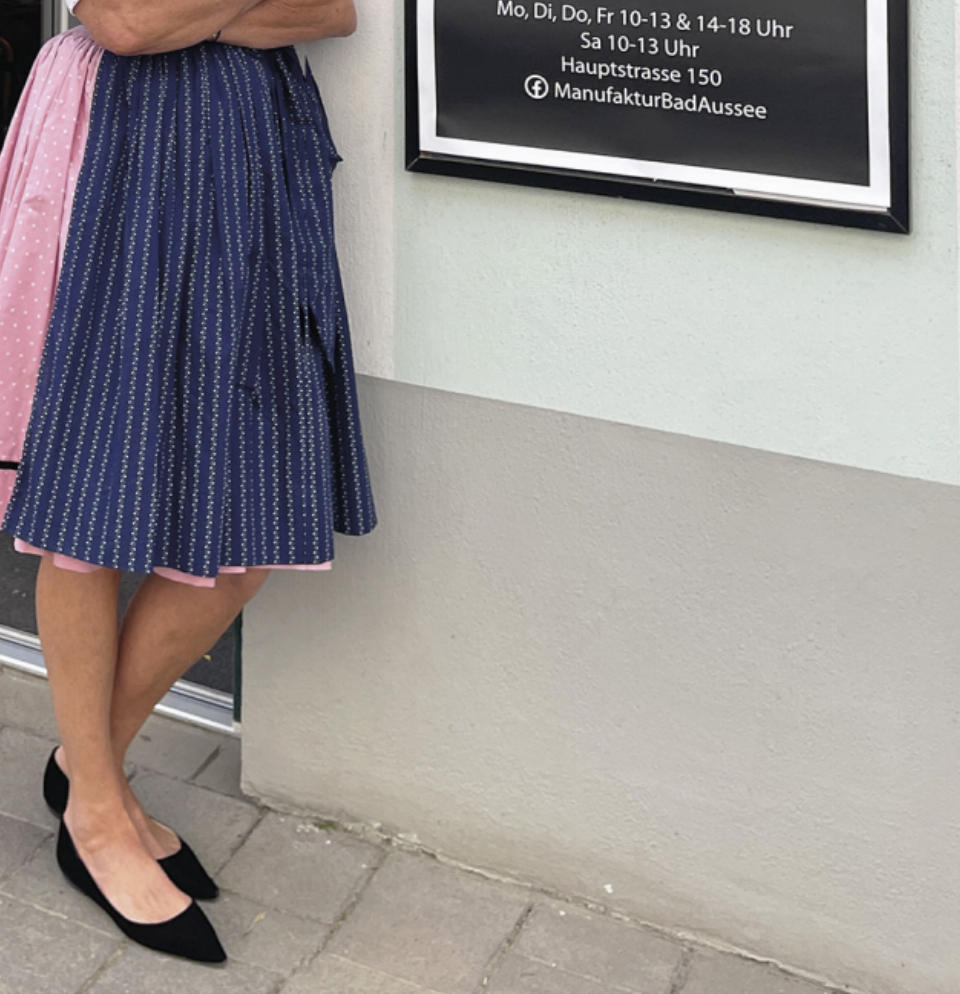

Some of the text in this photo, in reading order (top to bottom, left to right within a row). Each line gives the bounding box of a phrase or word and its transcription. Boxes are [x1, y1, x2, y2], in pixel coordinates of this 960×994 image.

[497, 0, 793, 37] Mo, Di, Do, Fr 10-13 & 14-18 Uhr
[581, 32, 699, 57] Sa 10-13 Uhr
[561, 56, 721, 86] Hauptstrasse 150
[554, 81, 767, 119] ManufakturBadAussee
